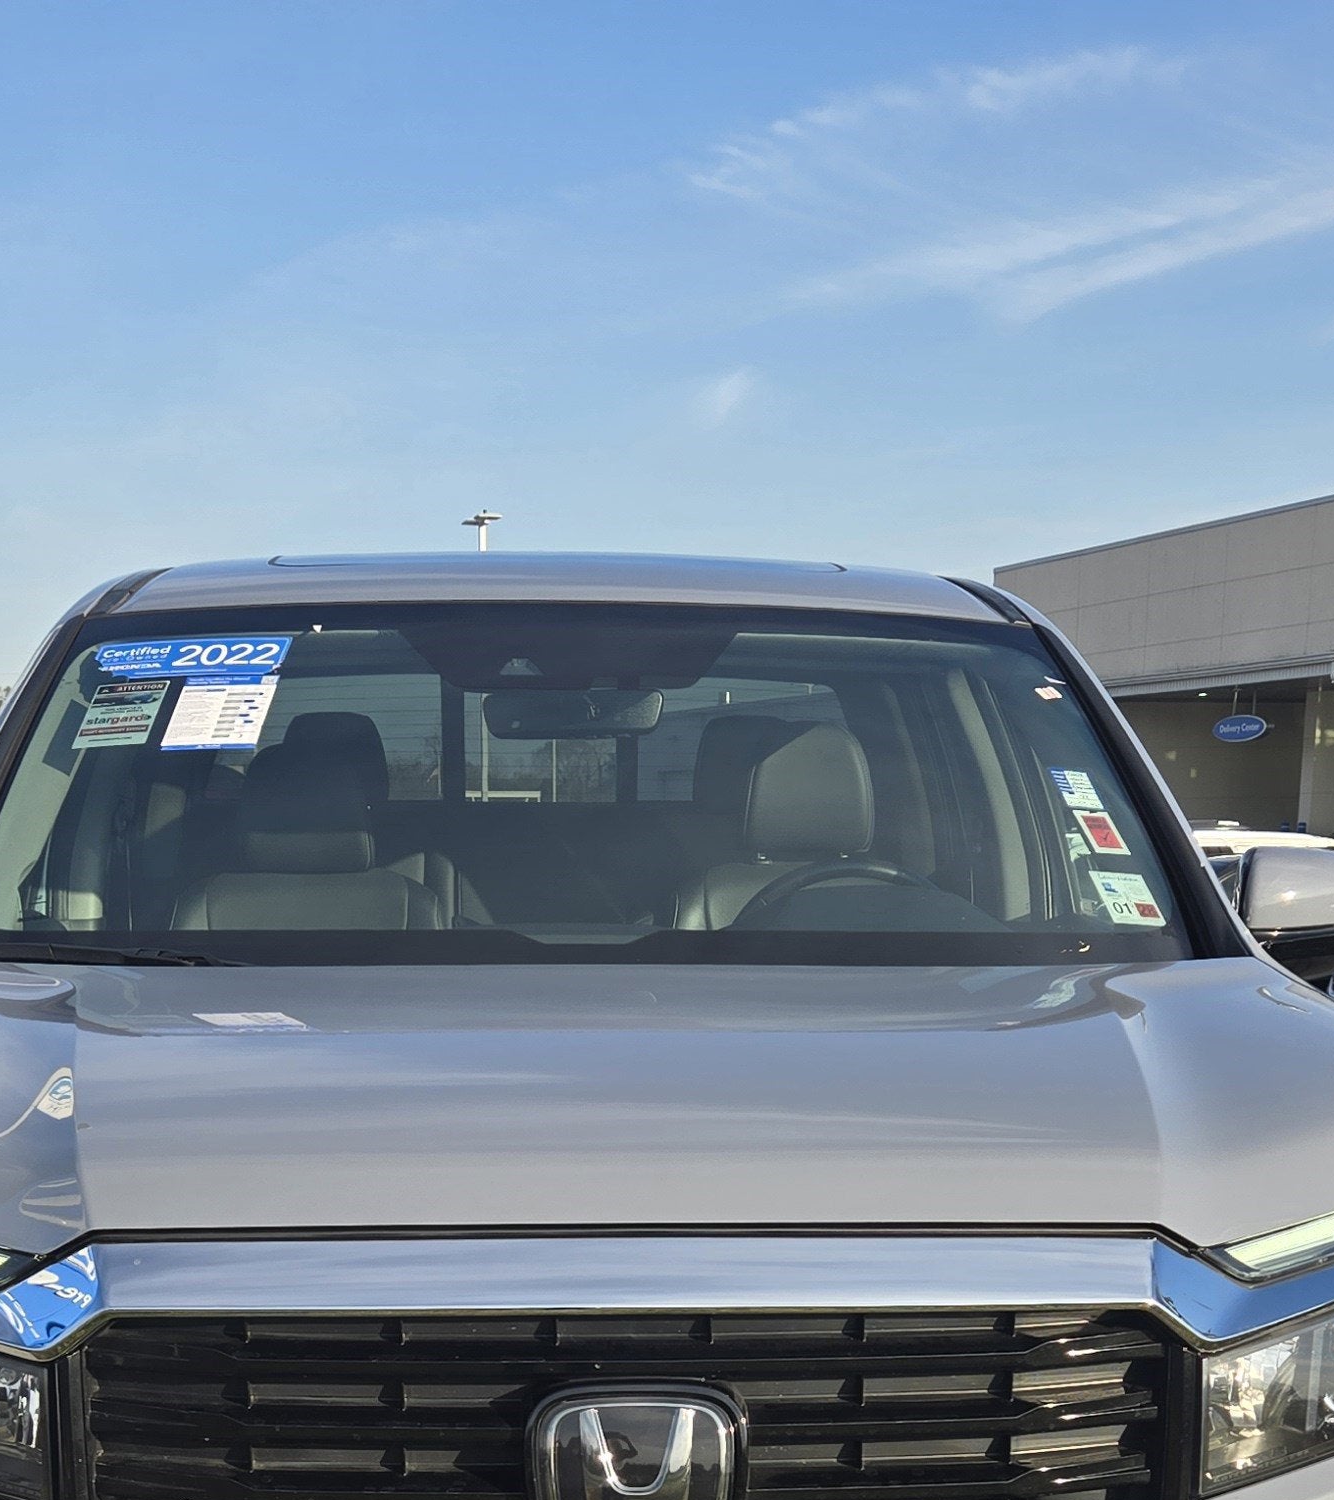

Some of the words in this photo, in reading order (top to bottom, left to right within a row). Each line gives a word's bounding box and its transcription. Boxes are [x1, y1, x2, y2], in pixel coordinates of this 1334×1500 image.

[103, 645, 172, 659] Certified
[171, 643, 281, 667] 2022
[116, 682, 164, 693] ATTENTION
[1219, 724, 1241, 734] Delivery
[1240, 722, 1260, 732] Center
[1112, 901, 1133, 915] 01
